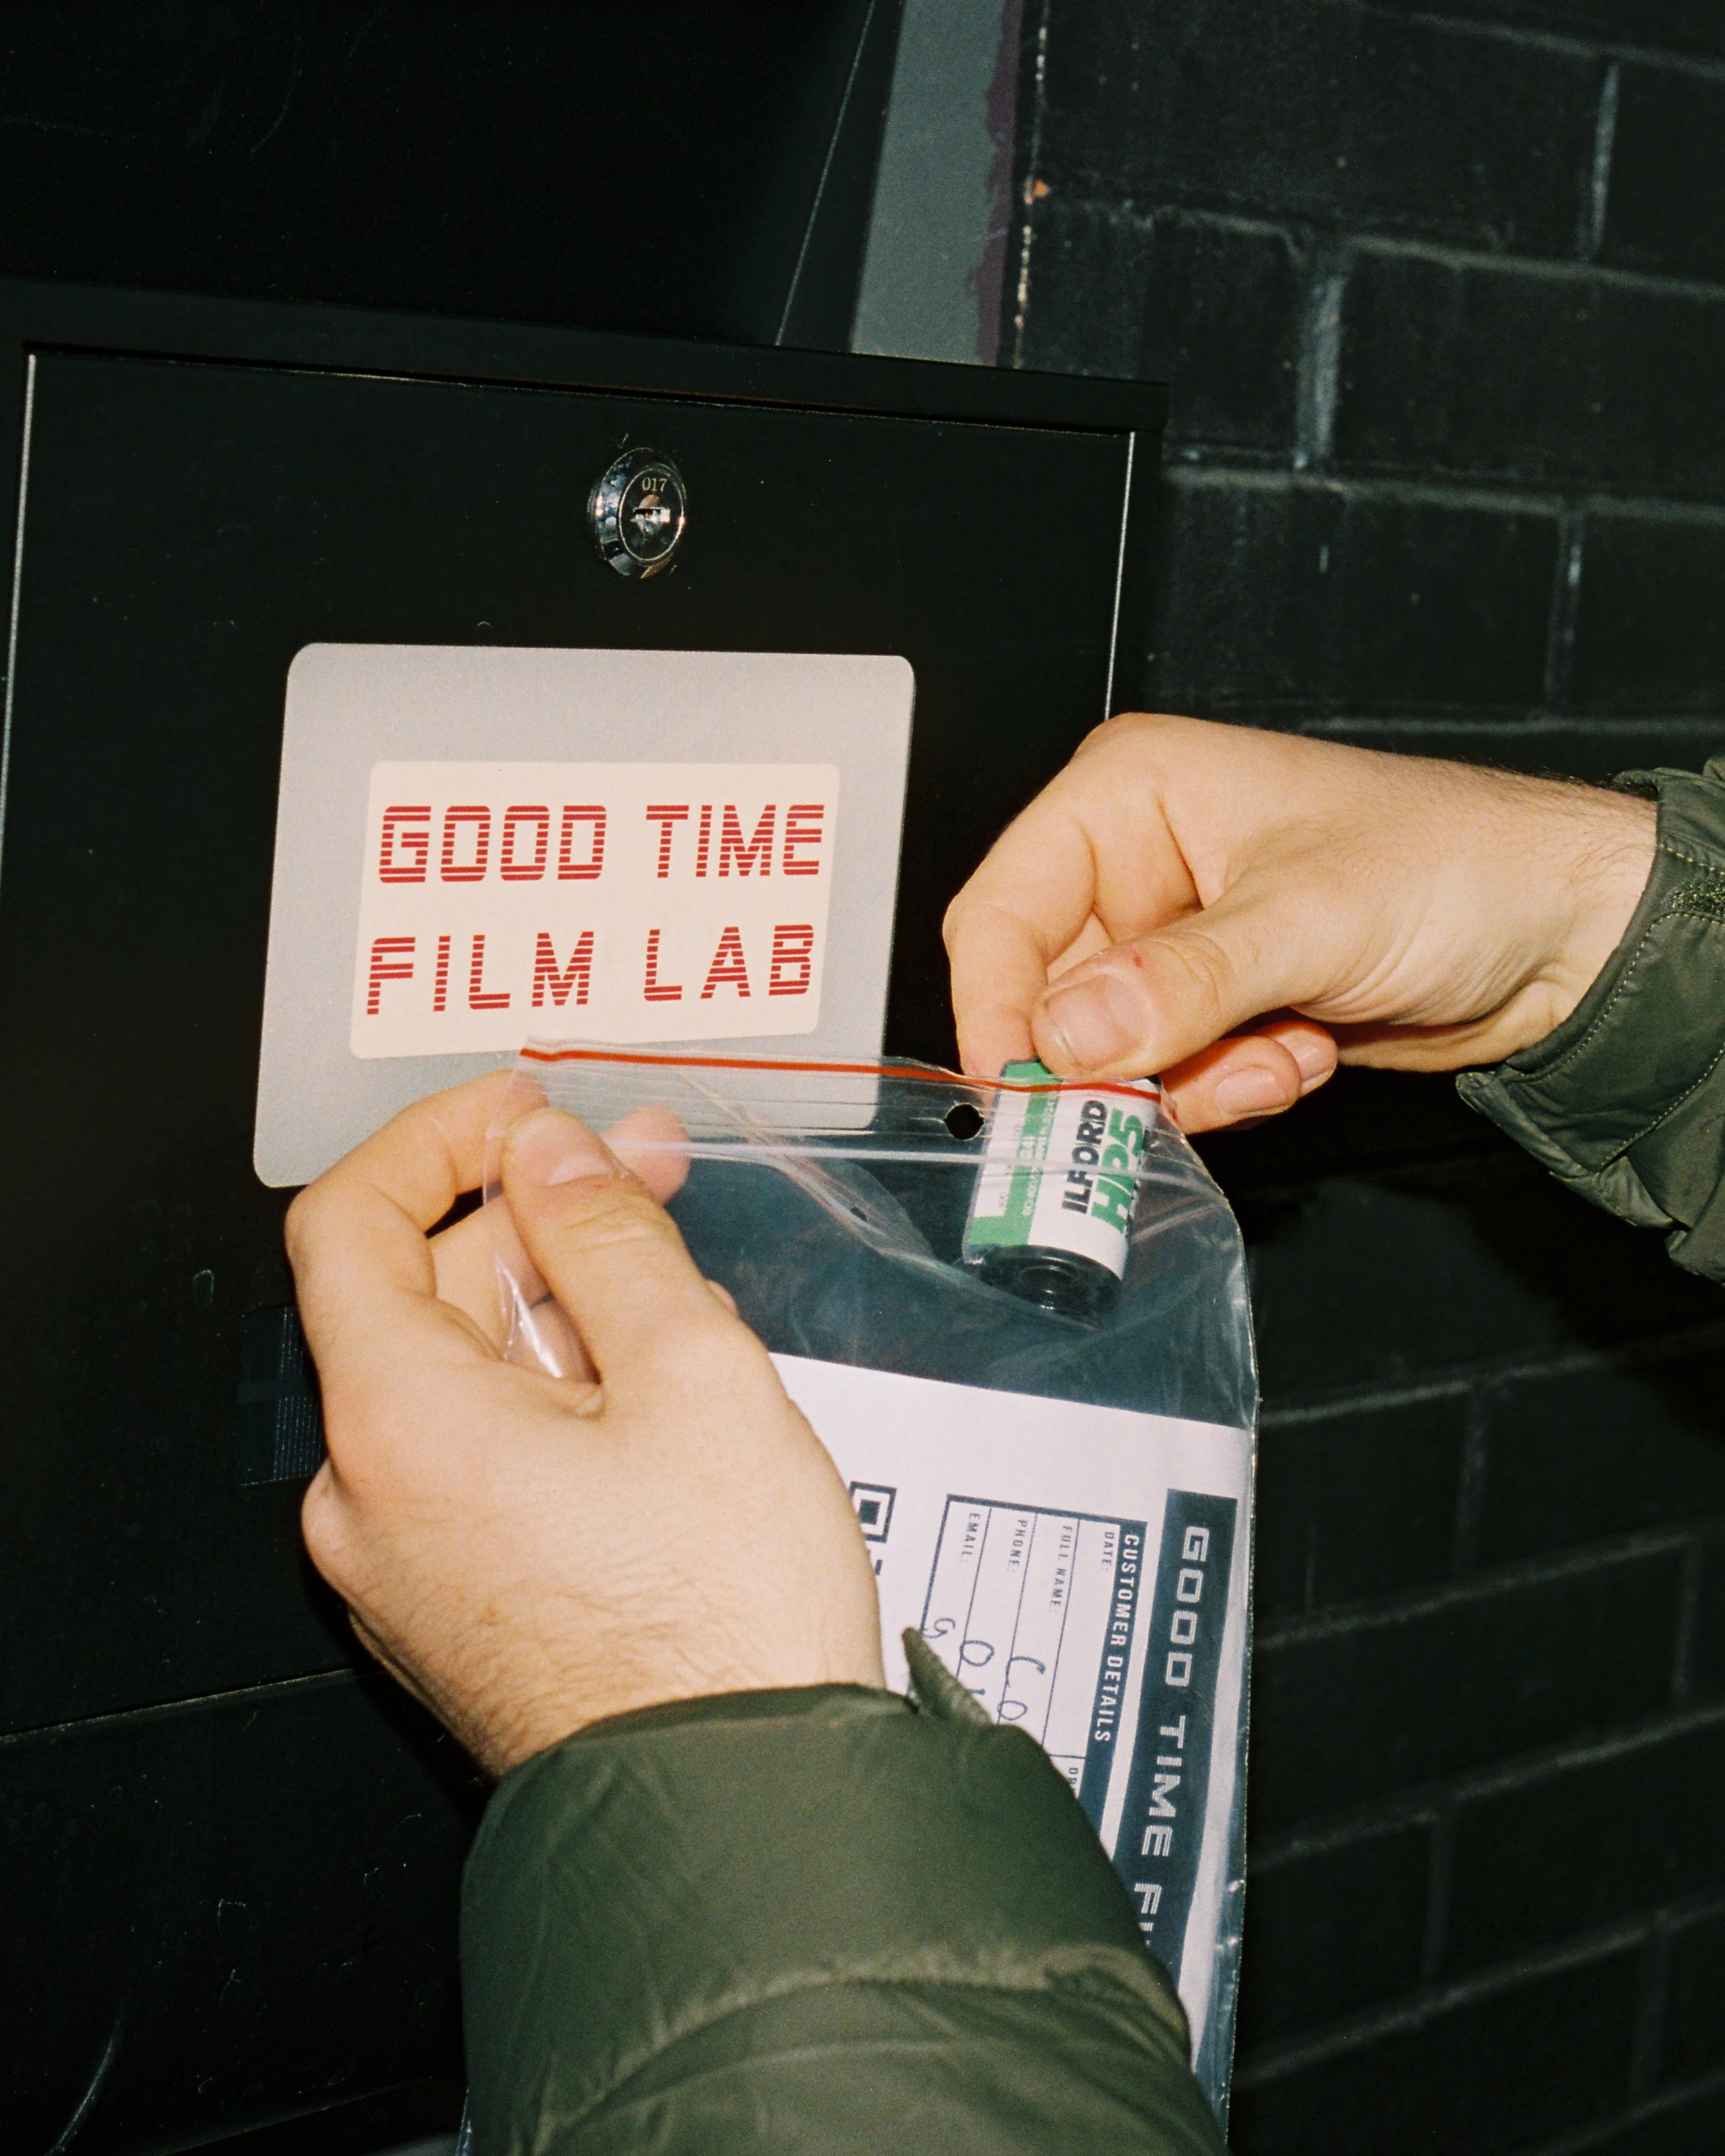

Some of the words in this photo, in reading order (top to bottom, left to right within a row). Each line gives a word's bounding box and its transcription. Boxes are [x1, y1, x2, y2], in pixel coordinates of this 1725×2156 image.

[642, 477, 668, 492] 017
[379, 805, 607, 883] GOOD
[645, 804, 825, 879] TIME
[366, 930, 595, 1015] FILM
[642, 924, 814, 1002] LAB
[1061, 1099, 1107, 1214] ILFORD
[1090, 1107, 1145, 1234] HP5
[960, 1512, 981, 1563] EMAIL:
[1006, 1519, 1027, 1572] PHONE:
[1058, 1525, 1073, 1562] FULL
[1101, 1531, 1115, 1572] DATE:
[1049, 1567, 1067, 1612] NAME:
[1110, 1534, 1140, 1646] CUSTOMER
[1165, 1525, 1210, 1688] GOOD
[1094, 1656, 1123, 1742] DETAILS
[1141, 1714, 1186, 1857] TIME
